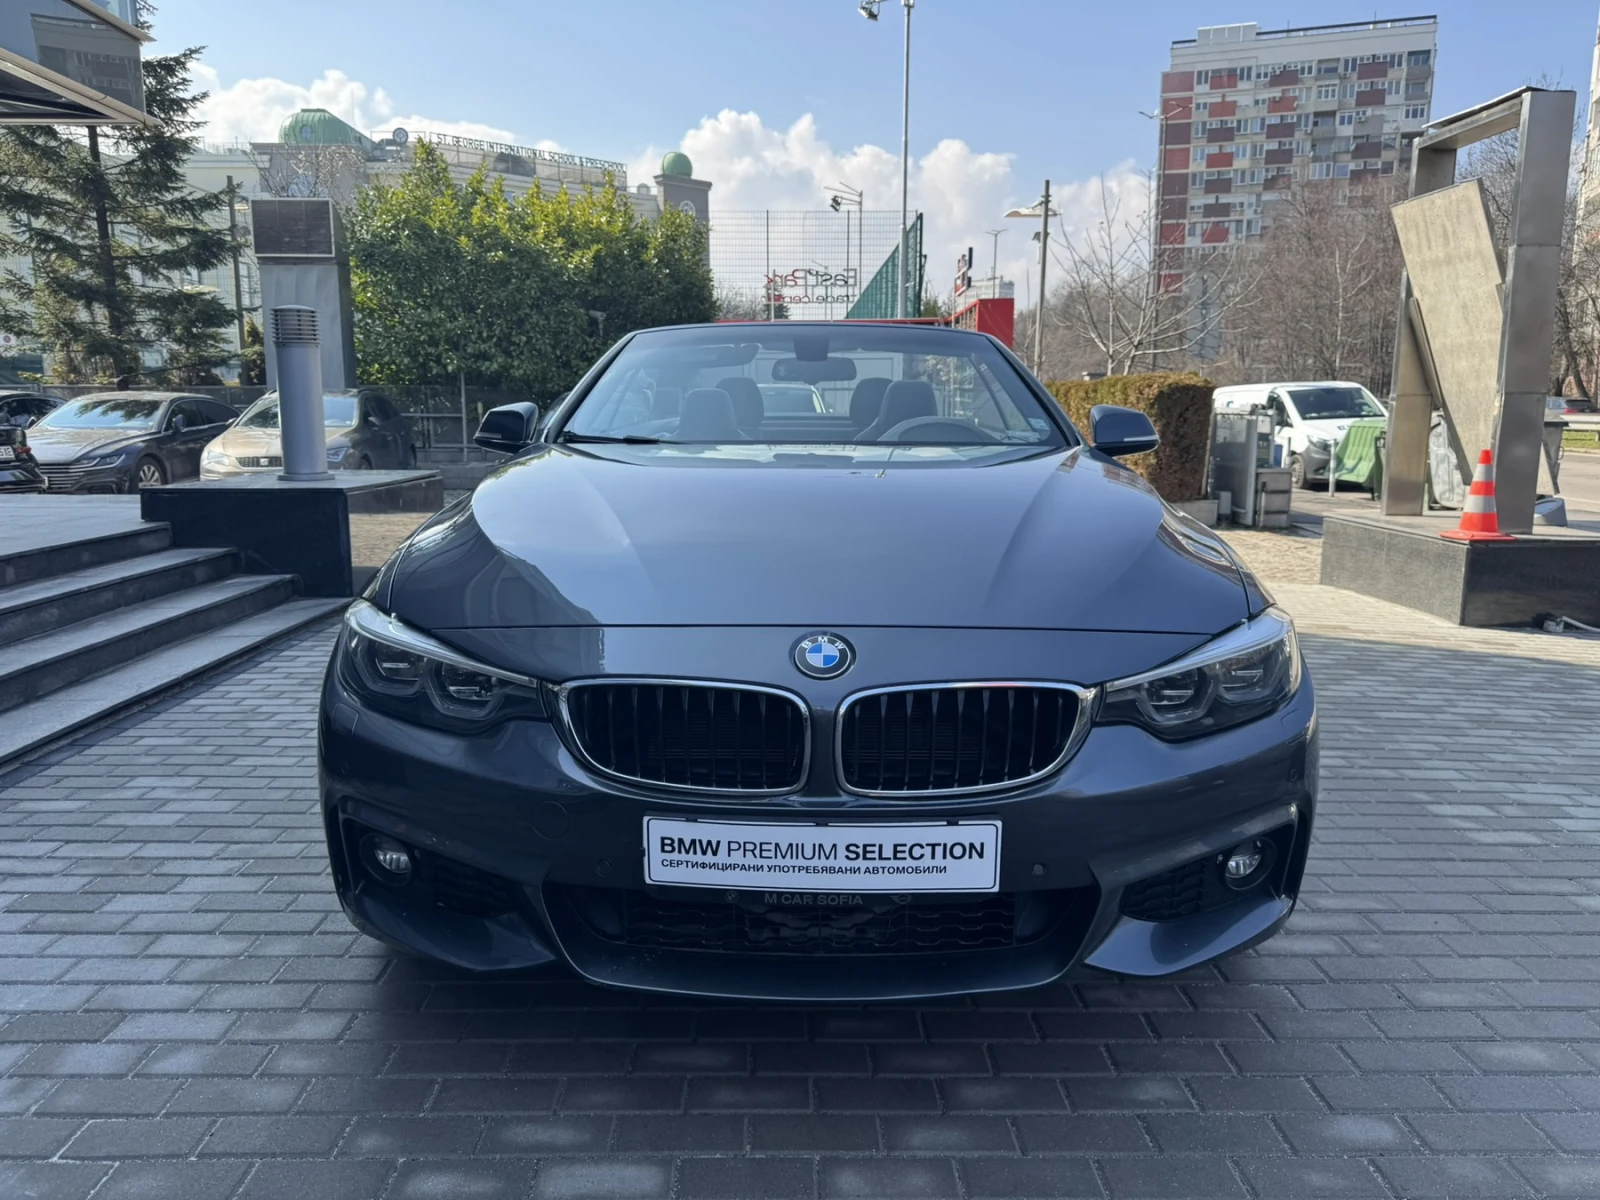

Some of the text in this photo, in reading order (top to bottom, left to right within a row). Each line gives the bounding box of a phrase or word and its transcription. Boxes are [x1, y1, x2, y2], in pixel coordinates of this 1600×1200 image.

[452, 135, 485, 151] GEORGE
[485, 140, 547, 161] INTERNATIONAL
[548, 150, 577, 166] SCHOOL
[585, 157, 627, 174] PRESCHOOL
[801, 636, 845, 649] BMW
[659, 836, 985, 861] BMW PREMIUM SELECTION
[661, 858, 947, 875] СЕРТИФИЦИРАНИ УПОТРЕБЯВАНИ АВТОМОБИЛИ
[764, 893, 863, 905] M CAR SOFIA
